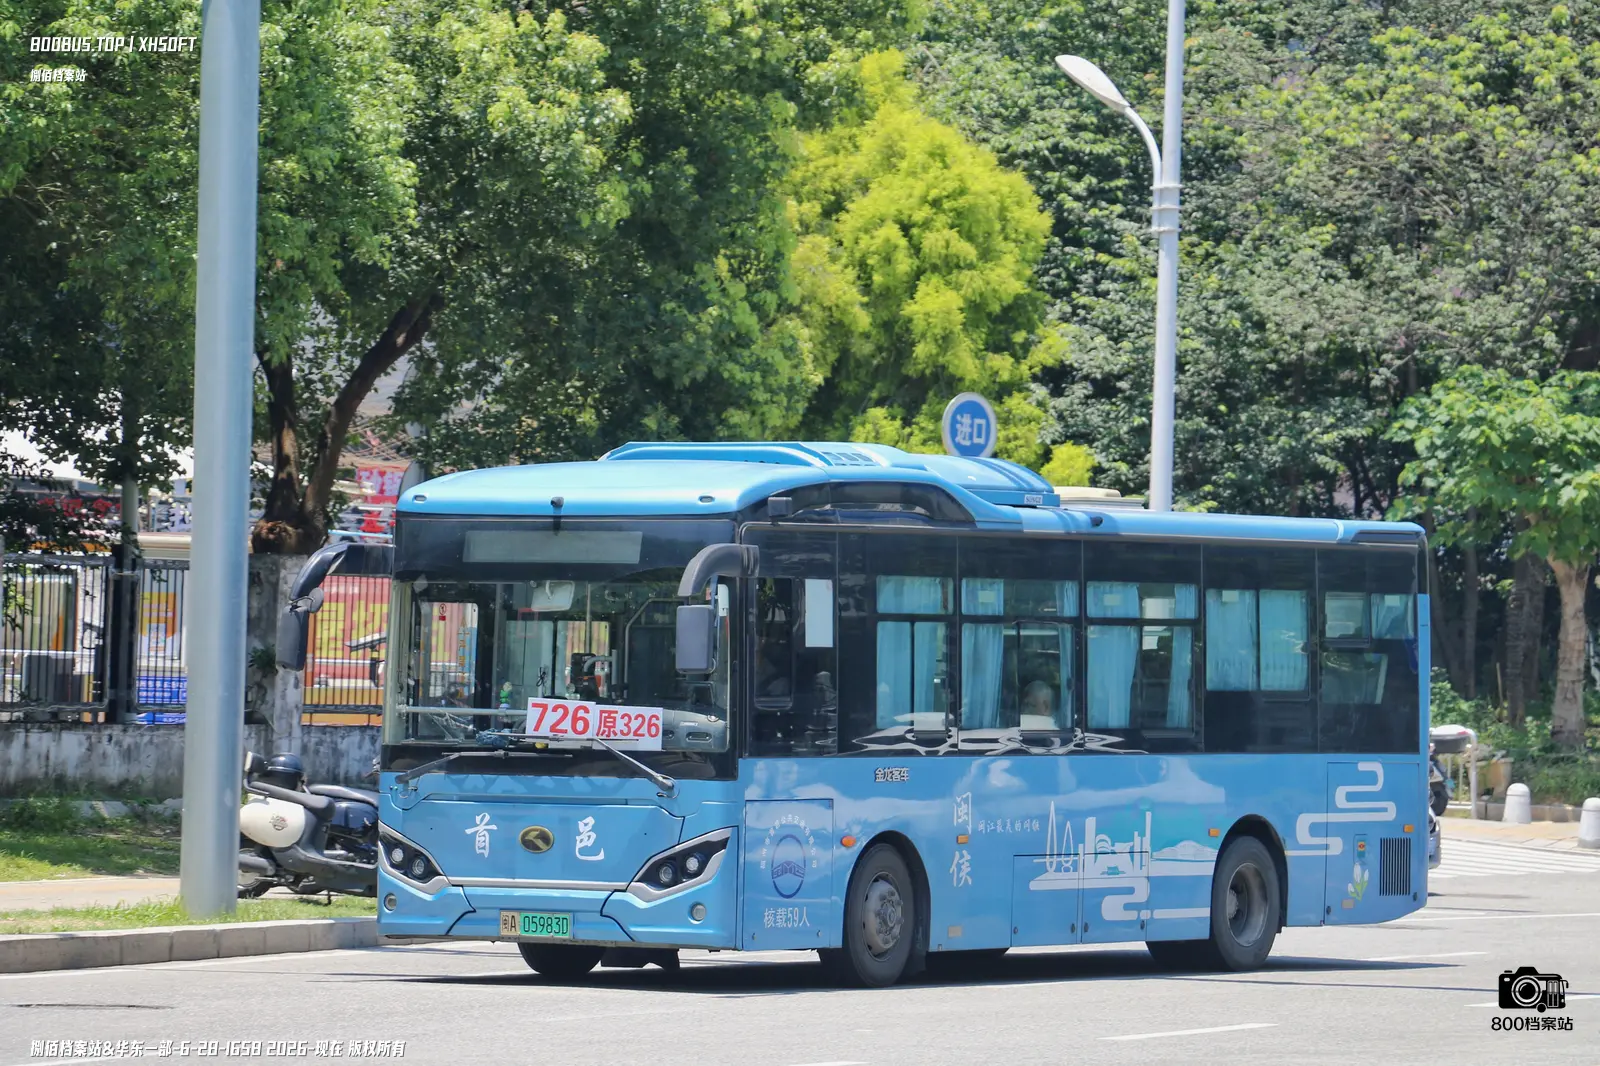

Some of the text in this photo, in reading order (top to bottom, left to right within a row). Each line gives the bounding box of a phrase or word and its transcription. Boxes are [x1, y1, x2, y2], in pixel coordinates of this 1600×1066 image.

[955, 413, 987, 446] 进口
[531, 702, 590, 735] 726
[596, 709, 660, 738] 原326
[875, 767, 909, 782] 金龙客车
[763, 906, 810, 929] 核载59人
